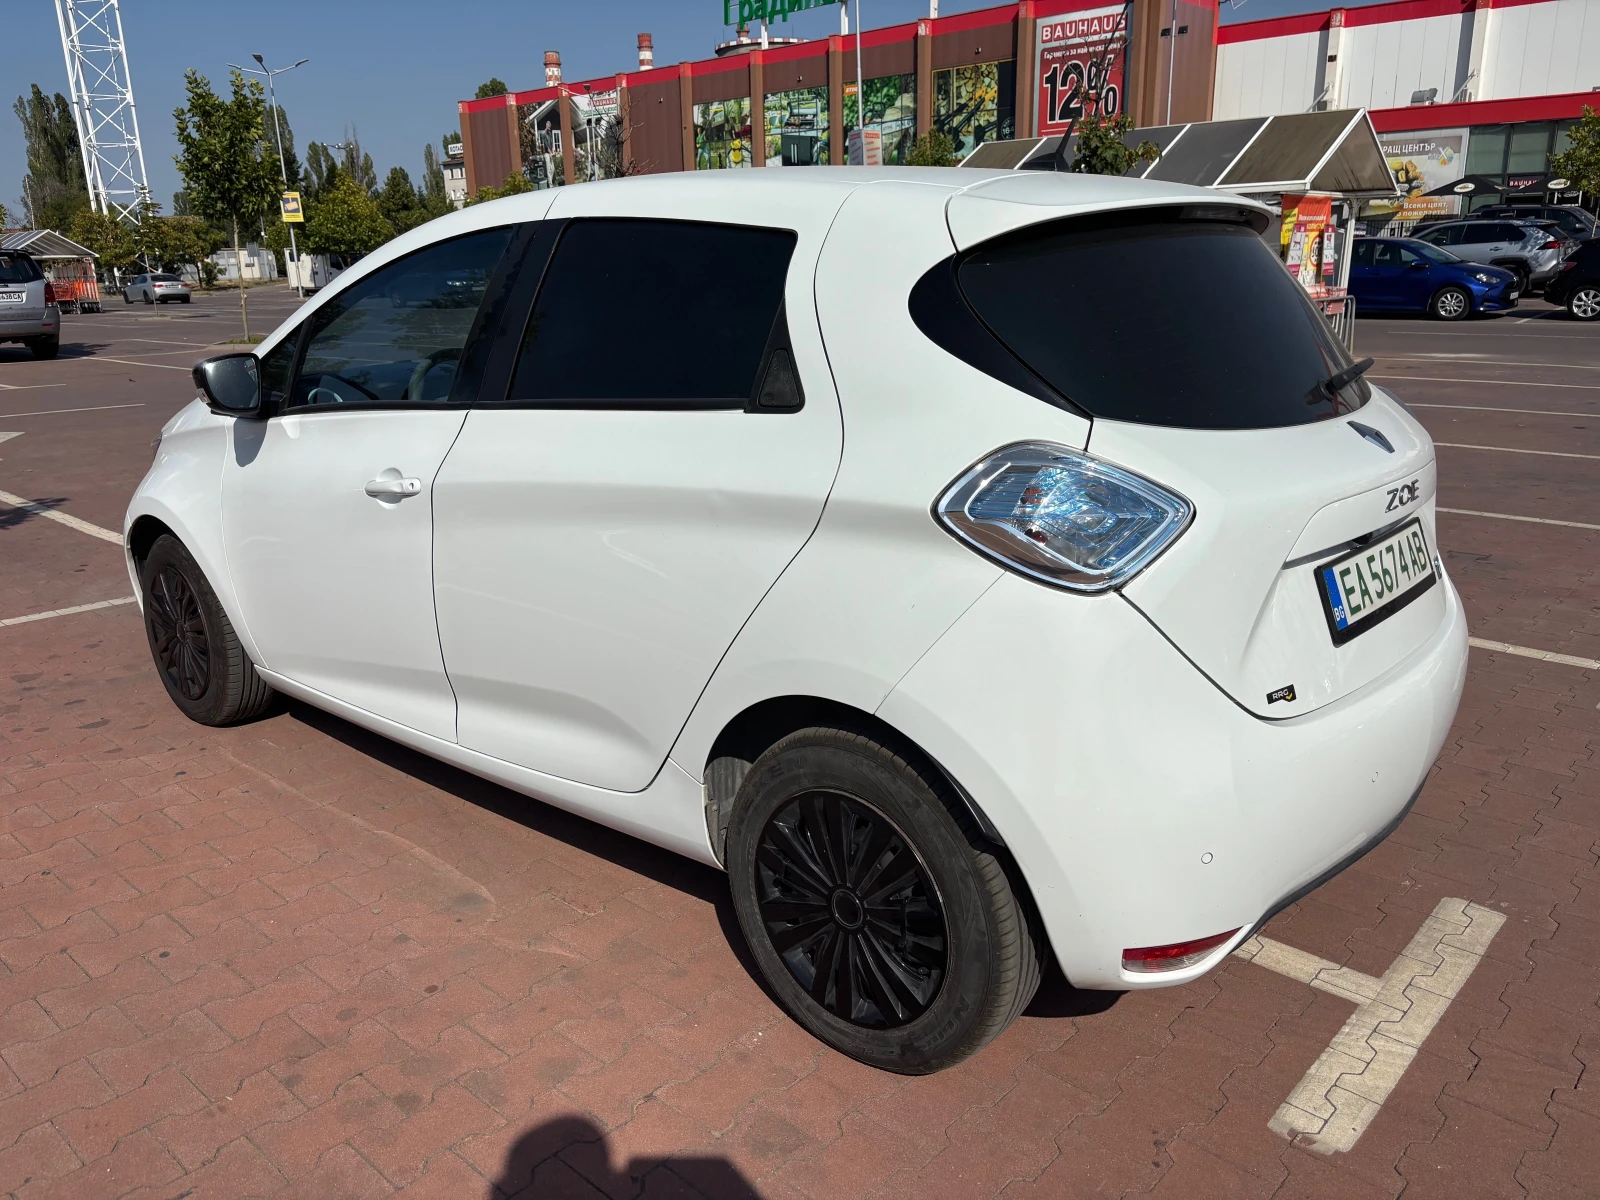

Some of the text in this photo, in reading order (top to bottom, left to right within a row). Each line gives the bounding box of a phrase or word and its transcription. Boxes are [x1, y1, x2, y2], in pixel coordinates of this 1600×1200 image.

[723, 0, 840, 30] Гради
[1042, 13, 1127, 42] BAUHAUS
[1043, 54, 1119, 124] 12%
[1382, 142, 1436, 155] РАЩ ЦЕНТЪР
[1385, 479, 1419, 513] ZOE
[1334, 605, 1345, 622] BG
[1272, 689, 1289, 700] RRG
